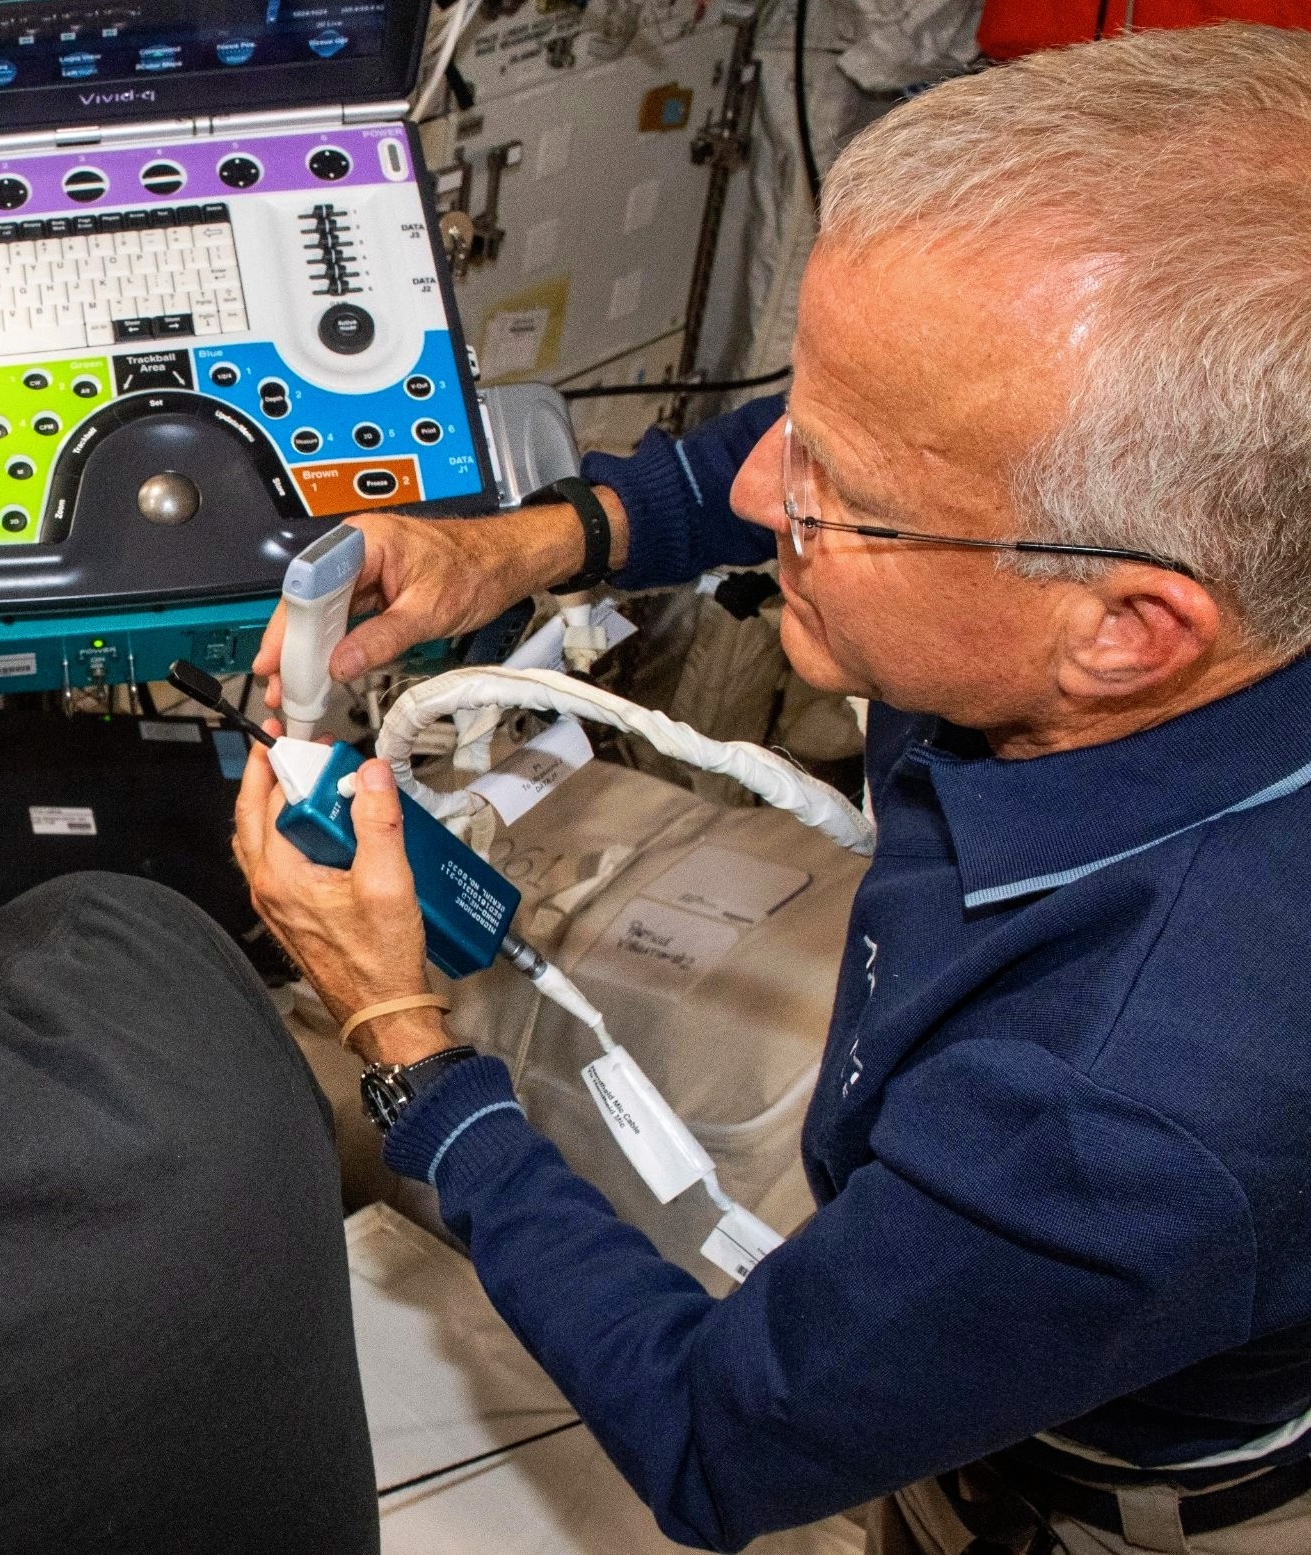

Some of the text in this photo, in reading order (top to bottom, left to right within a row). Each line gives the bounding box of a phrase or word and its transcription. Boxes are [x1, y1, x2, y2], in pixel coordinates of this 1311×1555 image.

[362, 128, 403, 138] POWER
[401, 224, 425, 232] DATA
[413, 277, 436, 285] DATA
[198, 349, 223, 358] Blue
[126, 353, 176, 365] Trackball
[70, 360, 102, 369] Green
[140, 363, 166, 373] Area
[440, 381, 446, 389] 3
[295, 390, 301, 399] 2
[149, 399, 163, 407] Set
[389, 429, 395, 438] 5
[448, 425, 455, 433] 6
[73, 427, 97, 455] Trackball
[327, 433, 334, 441] 4
[449, 456, 474, 465] DATA
[458, 465, 468, 473] J1
[302, 469, 339, 480] Brown
[403, 476, 410, 485] 2
[311, 483, 317, 492] 1
[55, 498, 66, 520] Zoom
[482, 888, 506, 912] SERIAL
[461, 892, 501, 928] HAND-HELD
[455, 896, 497, 935] MICROPHONE
[591, 1065, 641, 1135] Handheld Mic Cable
[614, 1113, 626, 1129] Mic
